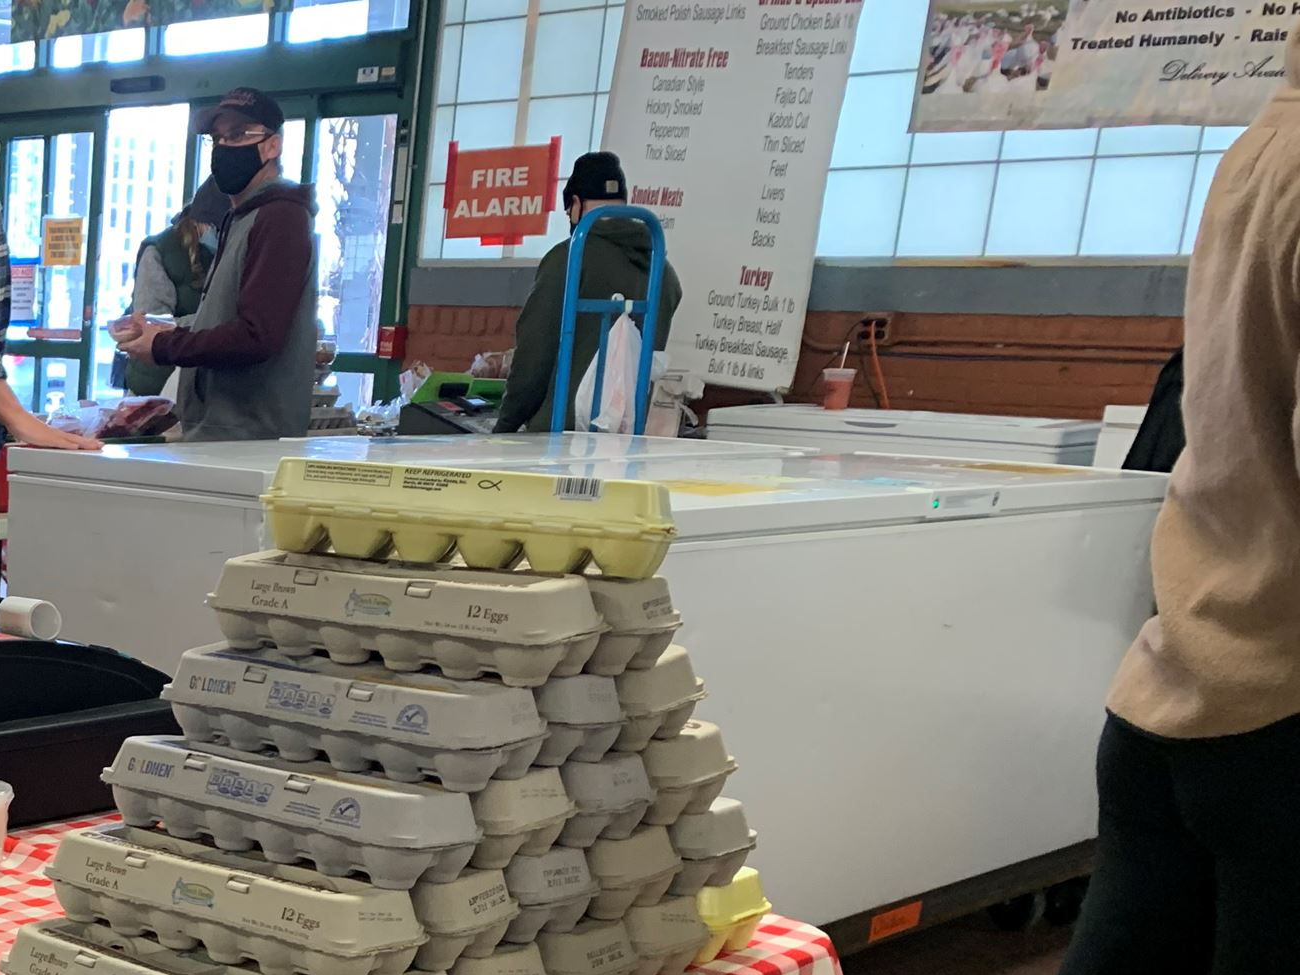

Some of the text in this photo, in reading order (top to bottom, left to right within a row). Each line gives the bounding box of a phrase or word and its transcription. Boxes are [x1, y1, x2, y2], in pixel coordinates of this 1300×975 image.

[636, 5, 746, 24] Smoked Polish Sausage Links
[760, 13, 790, 31] Ground
[791, 12, 823, 31] Chicken
[824, 12, 841, 30] Bulk
[1116, 11, 1137, 23] No
[1142, 5, 1235, 22] Antibiotics
[1262, 3, 1285, 16] No
[756, 38, 795, 55] Breakfast
[795, 38, 829, 59] Sausage
[1071, 35, 1133, 50] Treated
[1139, 31, 1225, 47] Humanely
[641, 48, 729, 68] Bacon-Nitrate Free
[784, 62, 814, 80] Tenders
[1159, 59, 1230, 85] Delivery
[652, 75, 705, 95] Canadian Style
[775, 87, 813, 106] Fajita Cut
[646, 99, 703, 118] Hickory Smoked
[768, 112, 810, 129] Kabob Cut
[646, 144, 687, 162] Thick Sliced
[763, 136, 806, 154] Thin Sliced
[471, 167, 529, 189] FIRE
[770, 160, 789, 177] Feet
[631, 185, 684, 207] Smoked Meats
[761, 184, 785, 201] Livers
[453, 196, 543, 218] ALARM
[756, 207, 781, 224] Necks
[751, 231, 776, 248] Backs
[740, 266, 773, 291] Turkey
[708, 289, 735, 308] Ground
[737, 292, 761, 313] Turkey
[762, 294, 779, 312] Bulk
[787, 296, 795, 314] lb
[712, 313, 736, 335] Turkey
[765, 318, 783, 336] Half
[695, 334, 719, 354] Turkey
[720, 336, 755, 356] Breakfast
[708, 358, 725, 374] Bulk
[740, 363, 746, 377] &
[422, 469, 472, 479] REFRIGERATED
[251, 580, 296, 595] Large Brown
[251, 595, 289, 609] Grade A
[467, 605, 509, 625] 12 Eggs
[189, 674, 235, 696] GLDHEN
[127, 757, 173, 778] GLDHEN
[86, 856, 127, 876] Large Brown
[86, 872, 119, 890] Grade A
[281, 907, 295, 922] 12
[295, 912, 320, 931] Eggs
[29, 947, 68, 970] Large Brown
